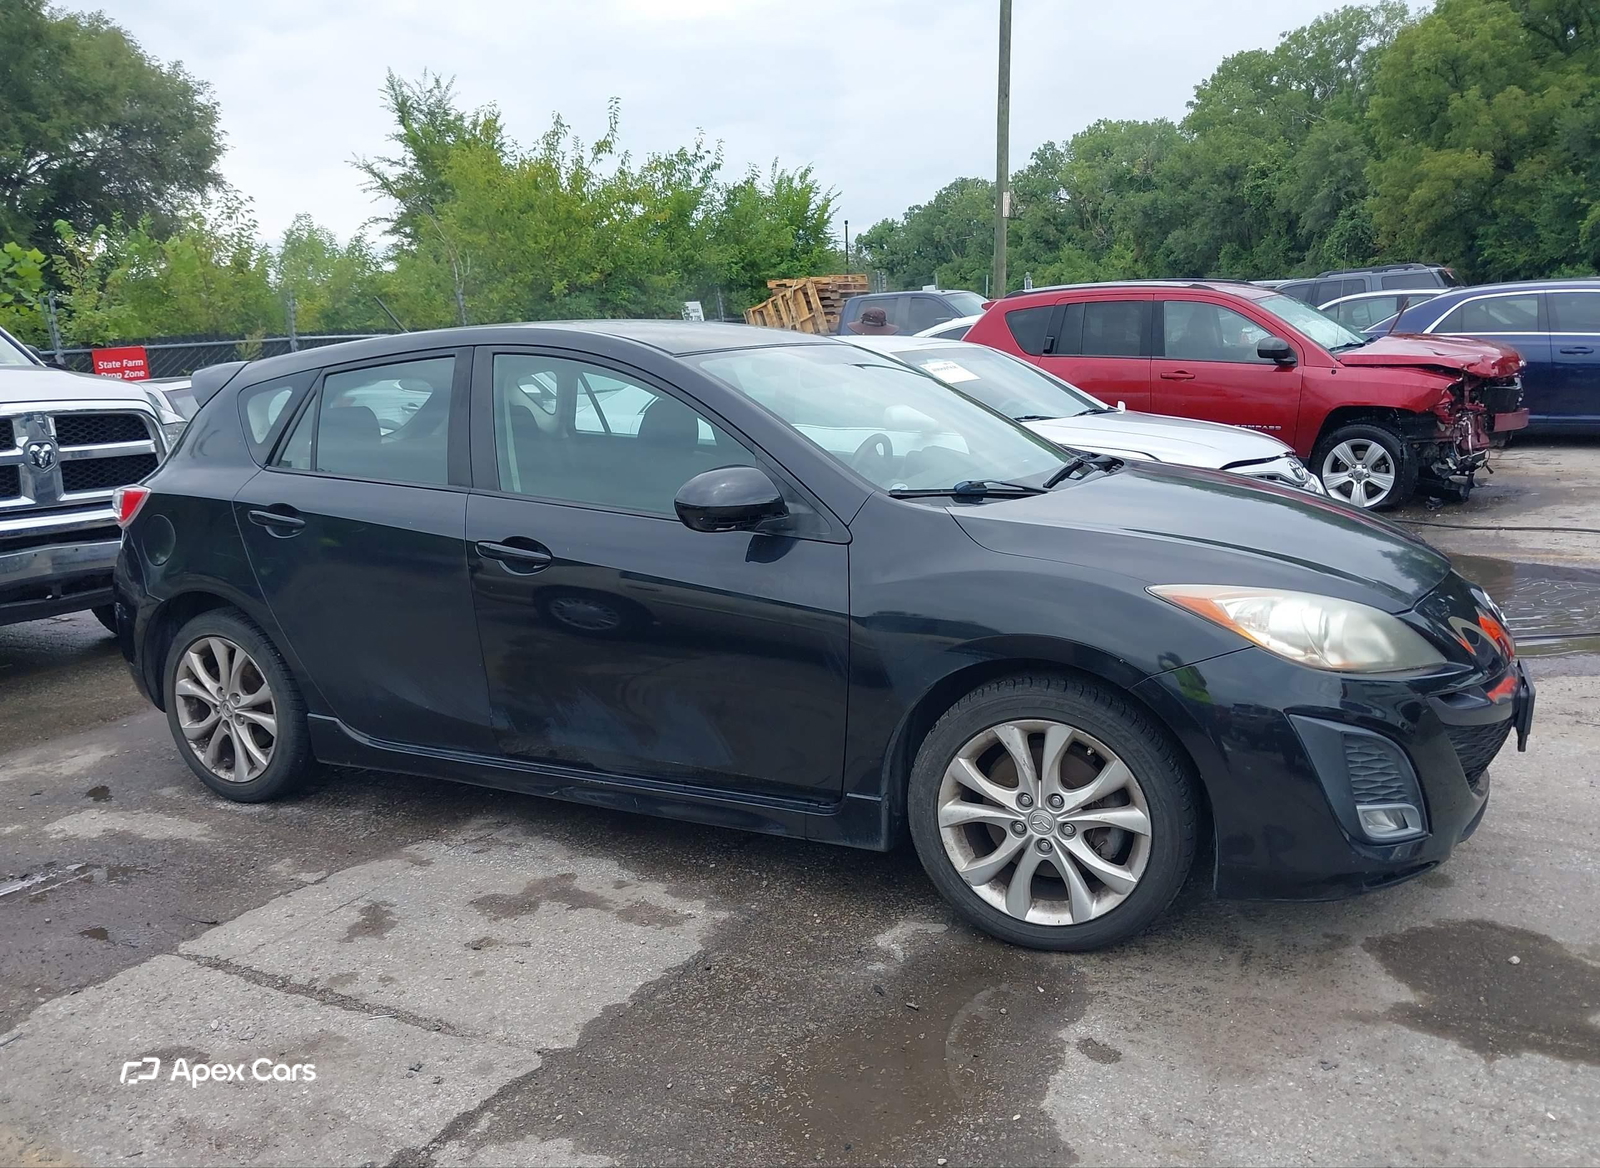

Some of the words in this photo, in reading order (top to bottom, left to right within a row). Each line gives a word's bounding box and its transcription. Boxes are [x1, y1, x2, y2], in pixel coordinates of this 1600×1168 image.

[98, 360, 121, 370] State
[123, 359, 144, 367] Farm
[124, 370, 145, 378] Zone
